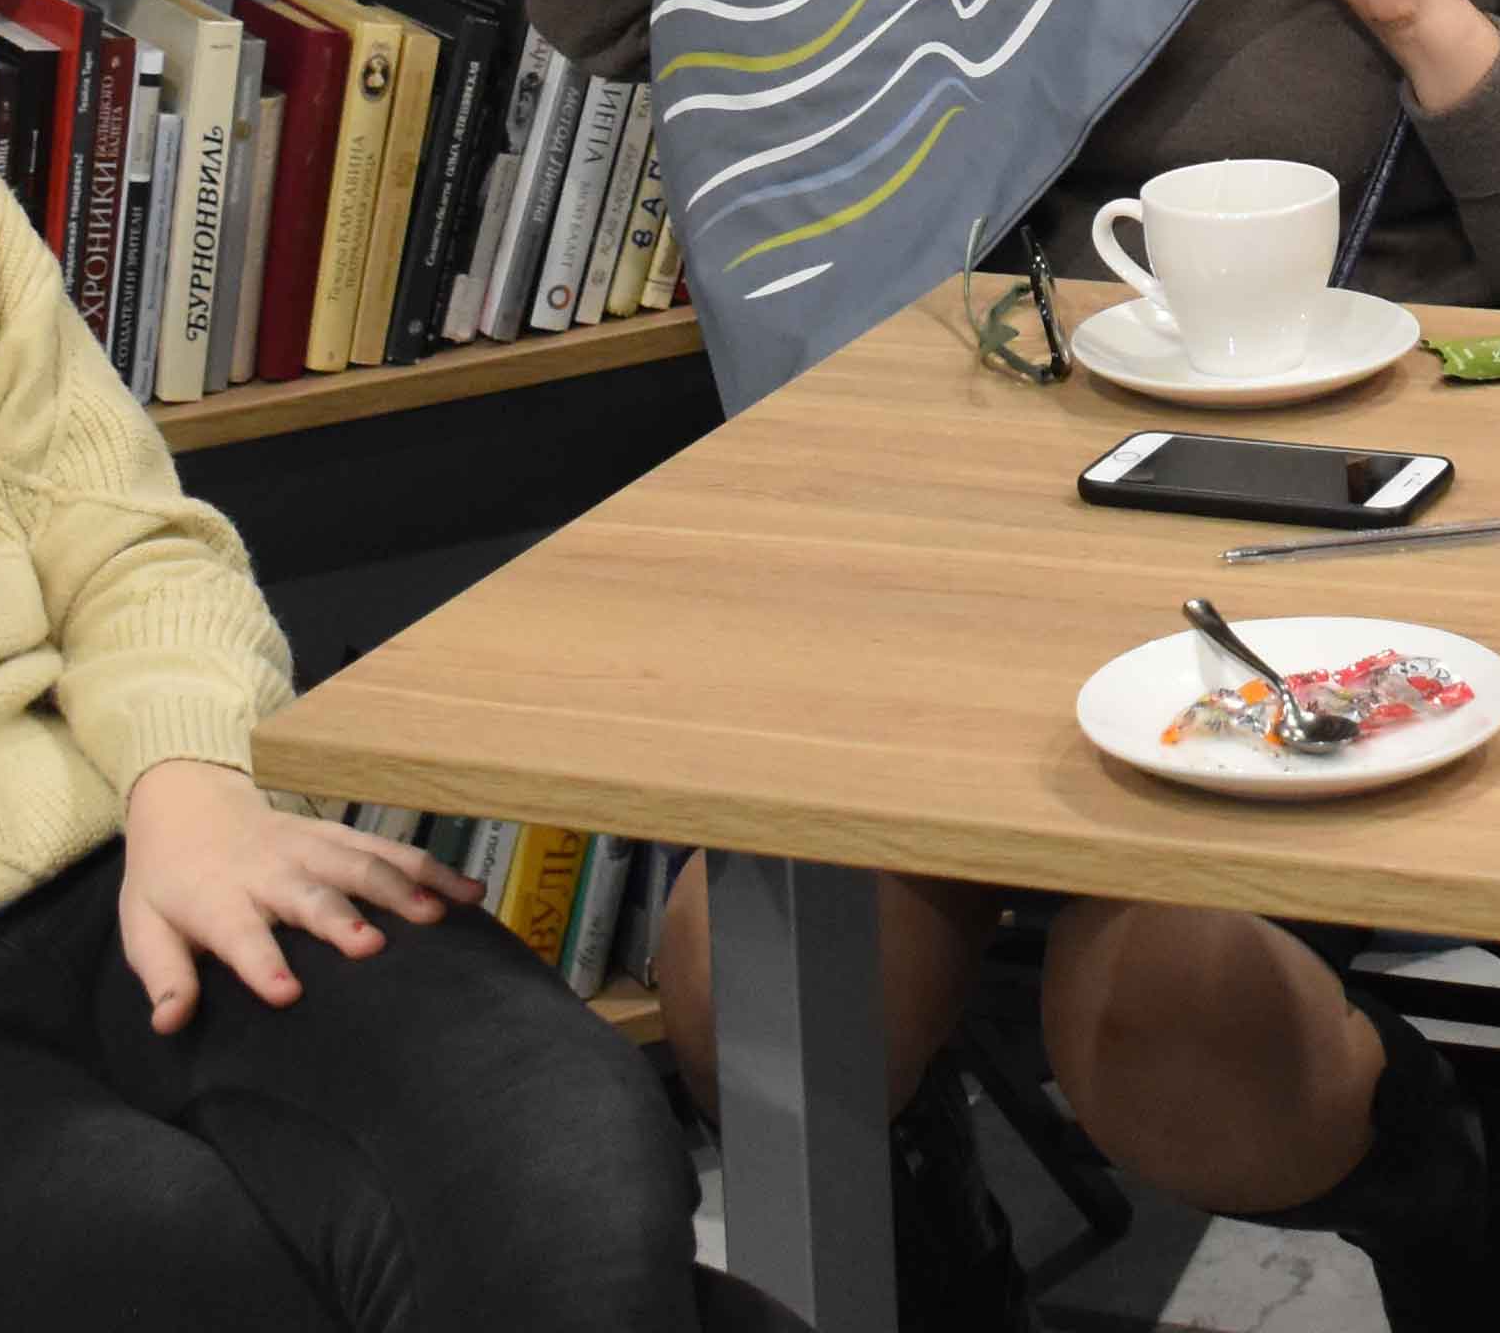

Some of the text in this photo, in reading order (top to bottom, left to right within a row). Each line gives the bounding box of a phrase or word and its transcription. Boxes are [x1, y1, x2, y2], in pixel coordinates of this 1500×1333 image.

[81, 161, 118, 322] ХРОНИКИ
[186, 126, 223, 341] БУРНОНВИЛЬ
[334, 135, 365, 244] КАРСАВИНА
